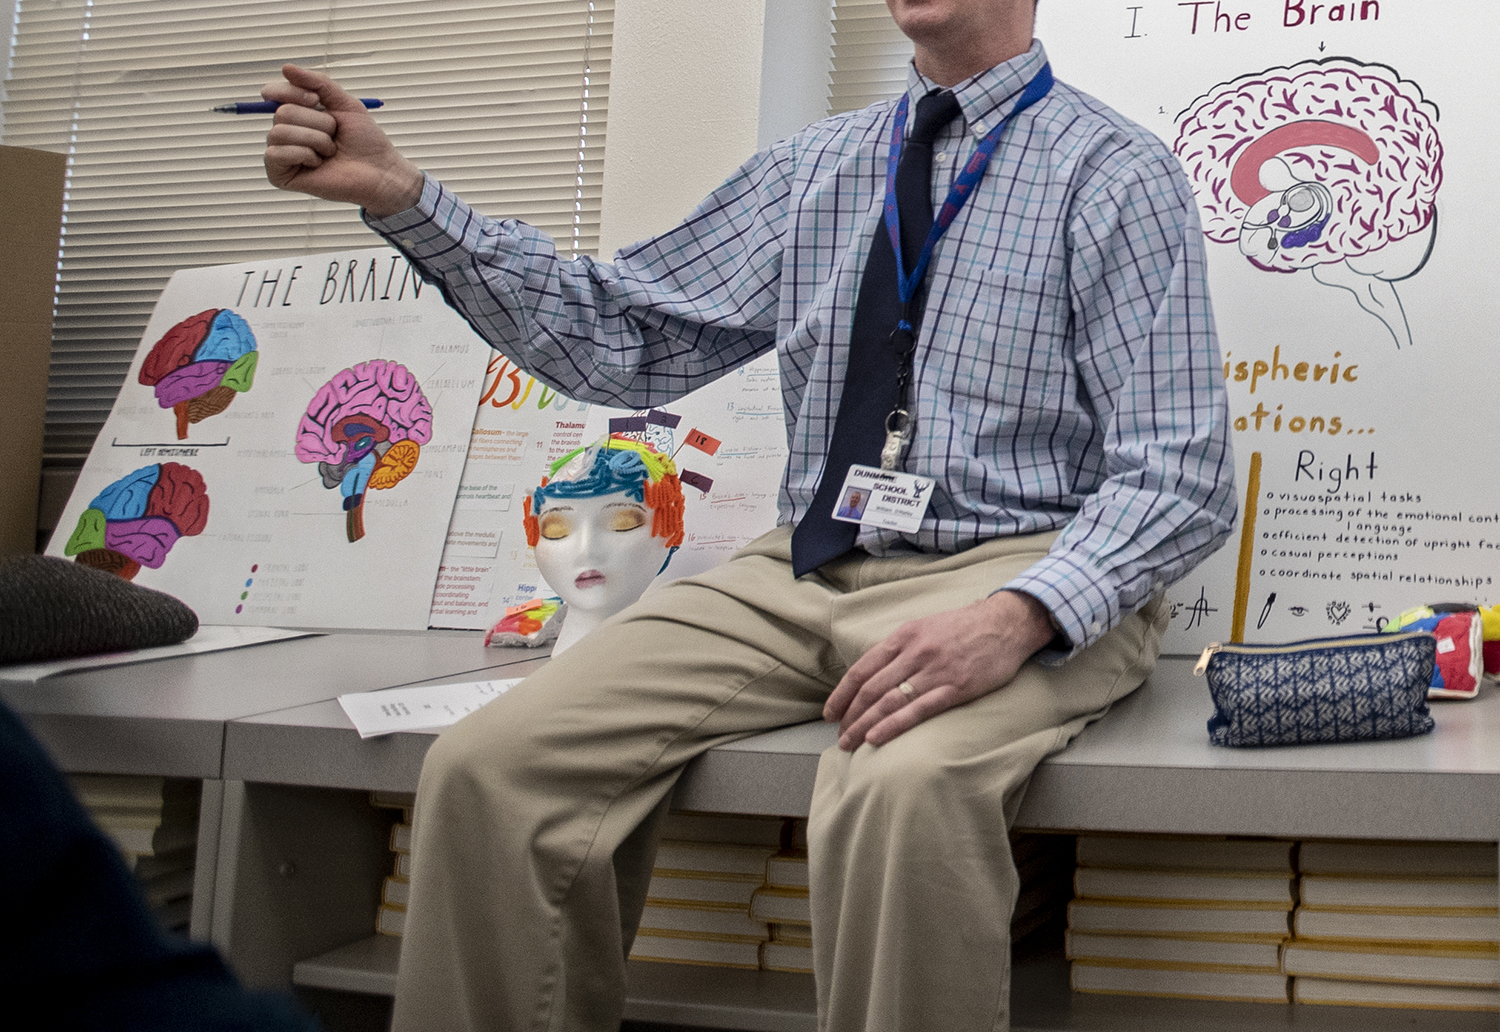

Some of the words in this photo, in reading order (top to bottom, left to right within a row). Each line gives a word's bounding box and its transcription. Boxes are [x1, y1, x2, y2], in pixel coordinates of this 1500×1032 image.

[1178, 0, 1251, 35] The
[236, 265, 302, 308] THE
[320, 255, 424, 306] BRAIN
[1223, 344, 1359, 395] ispheric
[1233, 402, 1375, 435] ations...
[1294, 449, 1379, 494] Right
[873, 482, 908, 496] SCHOOL
[1279, 491, 1371, 505] visuospatial
[1381, 491, 1422, 503] tasks
[881, 495, 922, 508] DISTRICT
[1274, 507, 1343, 522] processing
[1347, 507, 1362, 517] of
[1367, 509, 1388, 519] the
[1396, 510, 1462, 523] emotional
[1272, 530, 1327, 542] efficient
[1335, 533, 1399, 546] detection
[1405, 538, 1418, 547] of
[1424, 539, 1471, 551] upright
[1271, 549, 1312, 558] casual
[1317, 550, 1399, 562] perceptions
[1270, 569, 1342, 581] coordinate
[1350, 570, 1393, 582] spatial
[1399, 573, 1493, 590] relationships
